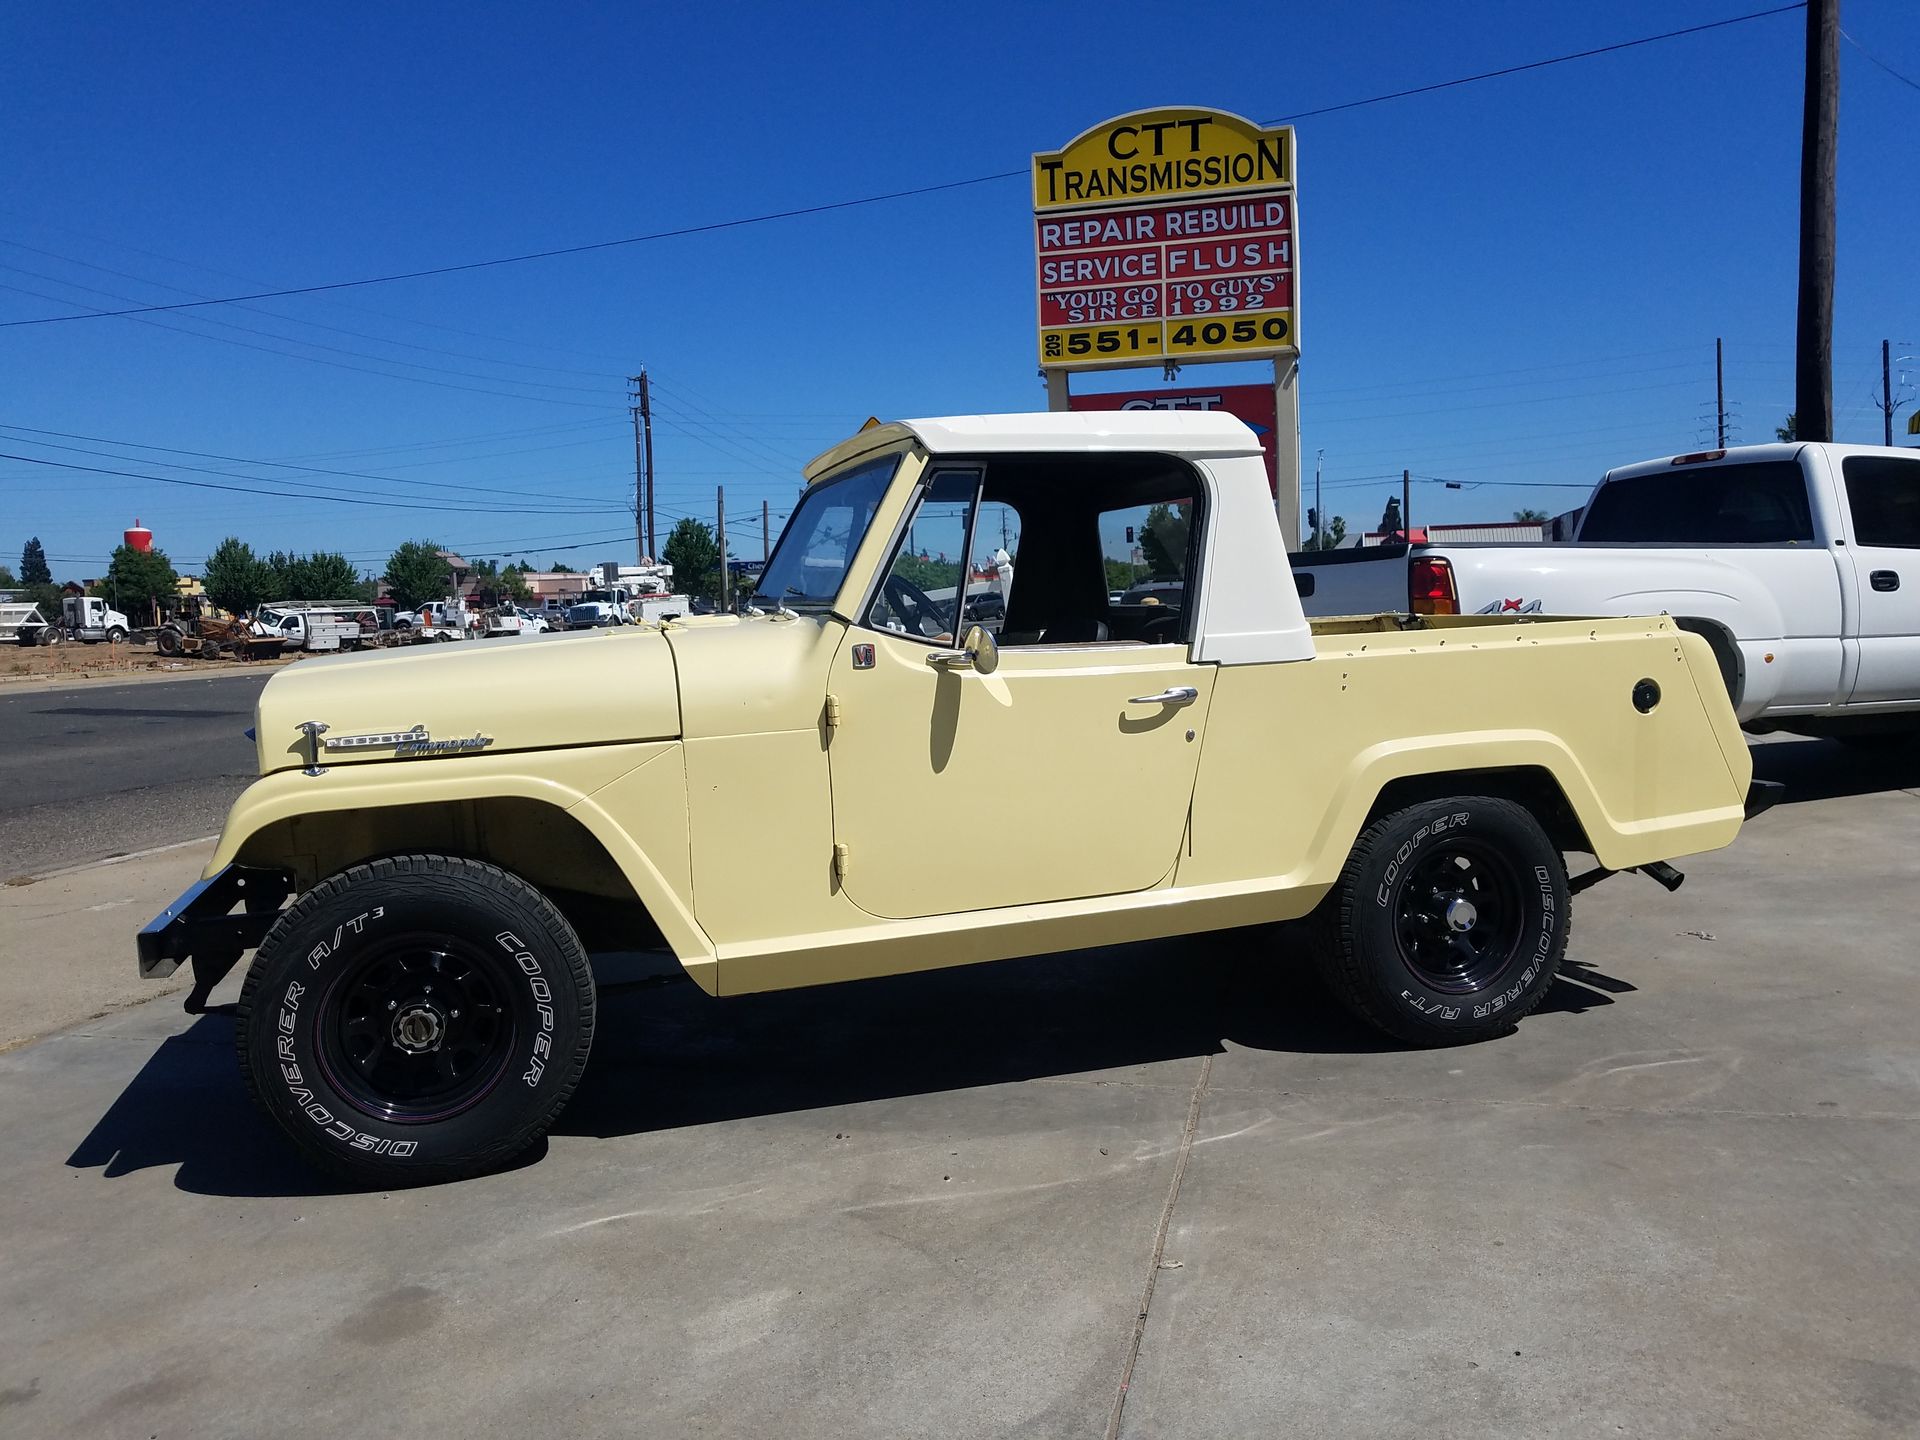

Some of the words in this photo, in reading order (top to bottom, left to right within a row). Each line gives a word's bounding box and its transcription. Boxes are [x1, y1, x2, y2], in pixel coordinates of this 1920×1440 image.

[1108, 116, 1213, 160] CTT
[1041, 136, 1284, 201] TRANSMISSION
[1042, 214, 1156, 248] REPAIR
[1165, 202, 1285, 236] REBUILD
[1043, 252, 1157, 284] SERVICE
[1169, 240, 1289, 272] FLUSH
[1067, 303, 1158, 323] SINCE
[1170, 294, 1265, 315] 1992
[1123, 286, 1158, 304] GO
[1170, 283, 1204, 301] TO
[1044, 334, 1062, 357] 209
[1376, 812, 1470, 907] COOPER
[1472, 865, 1555, 1019] DISCOVERER
[495, 931, 554, 1087] COOPER
[277, 980, 418, 1157] DISCOVERER
